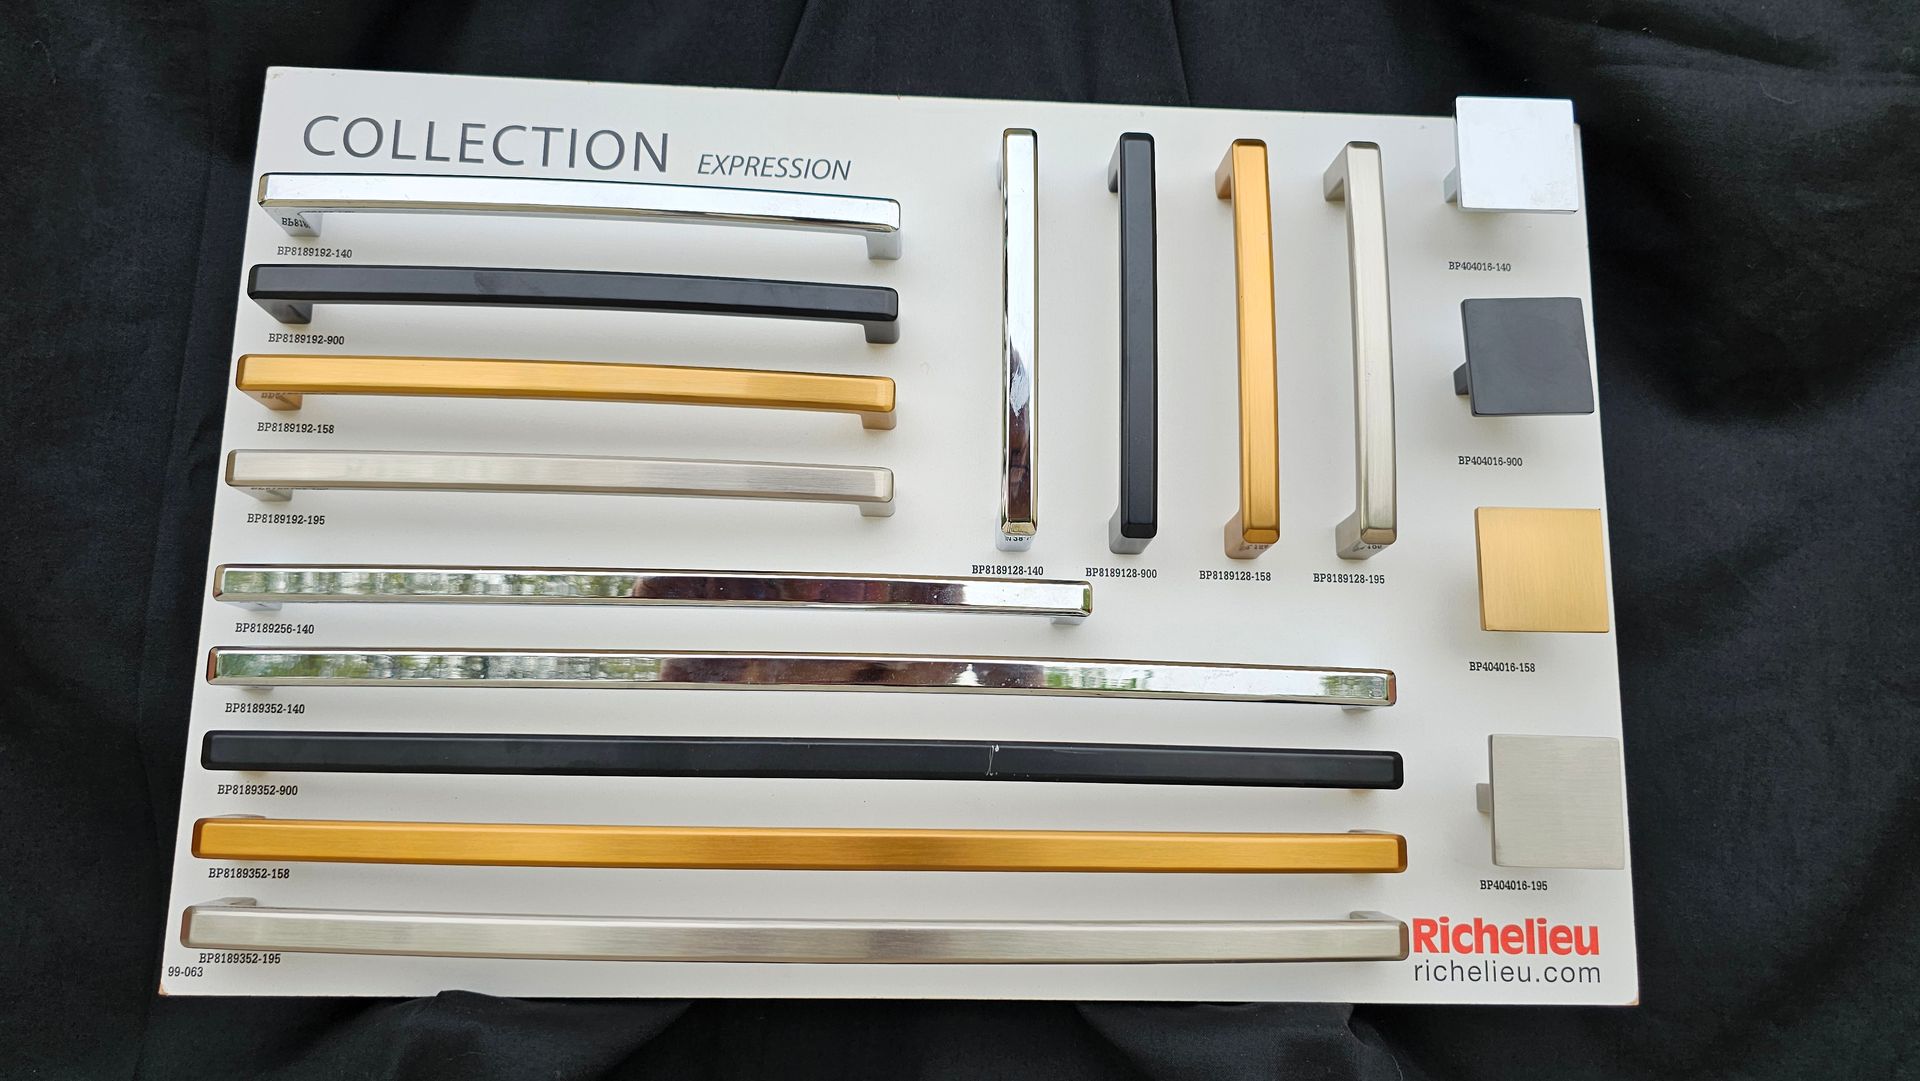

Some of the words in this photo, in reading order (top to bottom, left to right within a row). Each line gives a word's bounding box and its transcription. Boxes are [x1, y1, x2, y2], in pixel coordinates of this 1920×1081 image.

[303, 115, 669, 173] COLLECTION
[697, 153, 852, 181] EXPRESSION
[277, 246, 352, 259] BP8189192-140
[1449, 261, 1512, 272] BP404016-140
[268, 333, 345, 345] BP8189192-900
[257, 422, 335, 434] BP8189192-158
[1458, 456, 1523, 467] BP404016-900
[247, 513, 326, 526] BP8189192-195
[972, 565, 1044, 576] BP8189128-140
[1085, 568, 1158, 579] BP8189128-900
[1199, 571, 1272, 582] BP8189128-158
[1313, 573, 1385, 585] BP8189128-195
[235, 623, 315, 635] BP8189256-140
[1469, 662, 1536, 673] BP404016-158
[225, 703, 305, 715] BP8189352-140
[217, 785, 298, 797] BP8189352-900
[208, 868, 291, 880] BP8189352-158
[1480, 880, 1548, 891] BP404016-195
[1412, 916, 1600, 956] Richelieu
[199, 953, 281, 965] BP8189352-195
[168, 966, 203, 978] 99-063
[1414, 959, 1601, 984] richelieu.com
